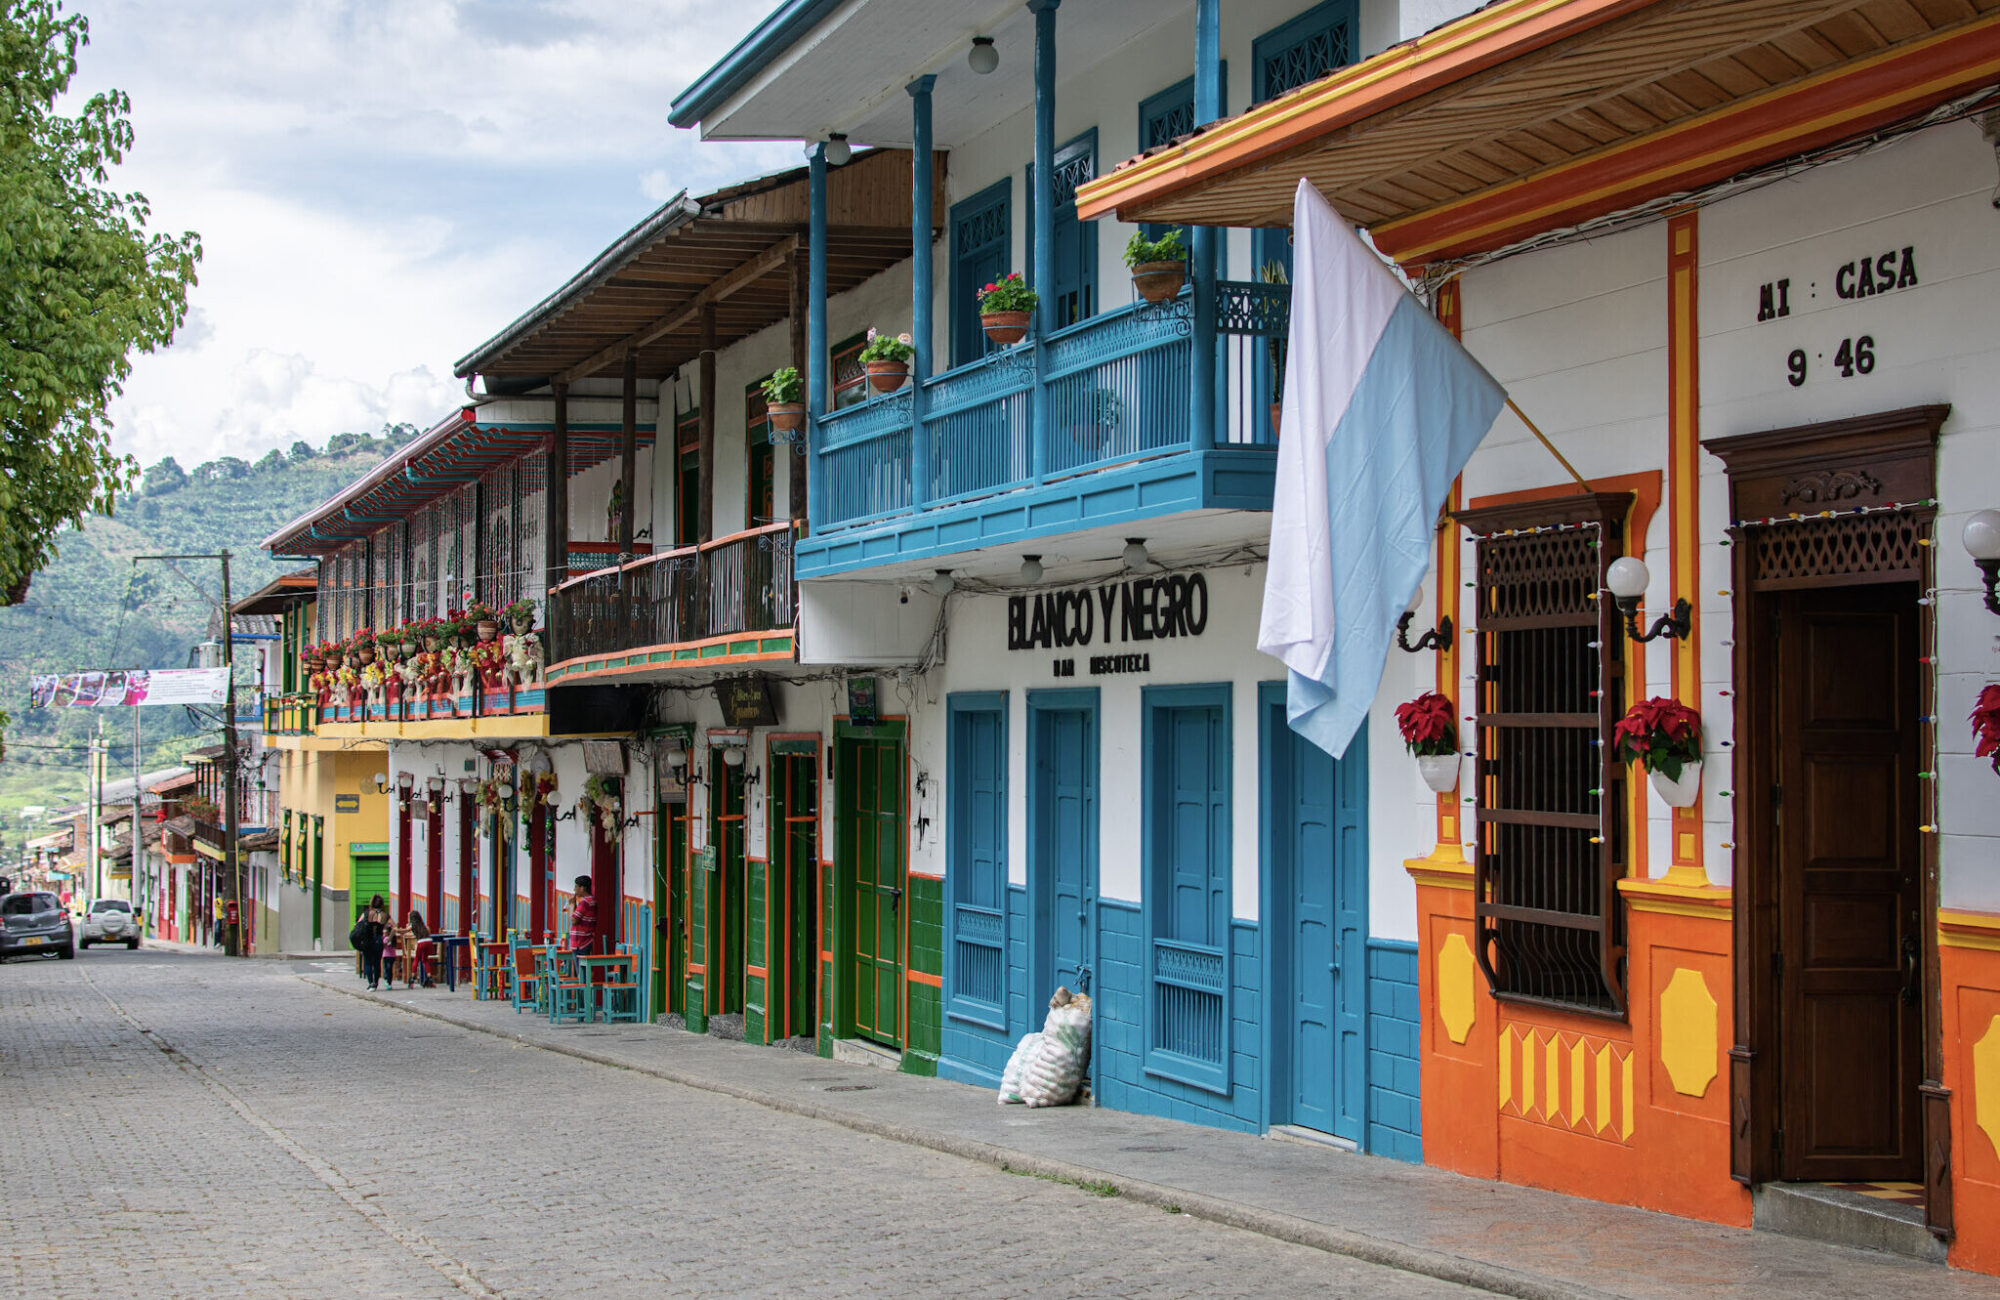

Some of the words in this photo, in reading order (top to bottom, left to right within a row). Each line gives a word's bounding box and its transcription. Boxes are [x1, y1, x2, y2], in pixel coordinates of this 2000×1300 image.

[1758, 278, 1790, 322] MI
[1836, 246, 1918, 299] CASA
[1008, 588, 1093, 650] BLANCO
[1098, 584, 1118, 643] Y
[1121, 572, 1208, 642] NEGRO
[1090, 653, 1150, 675] DISCOTECA
